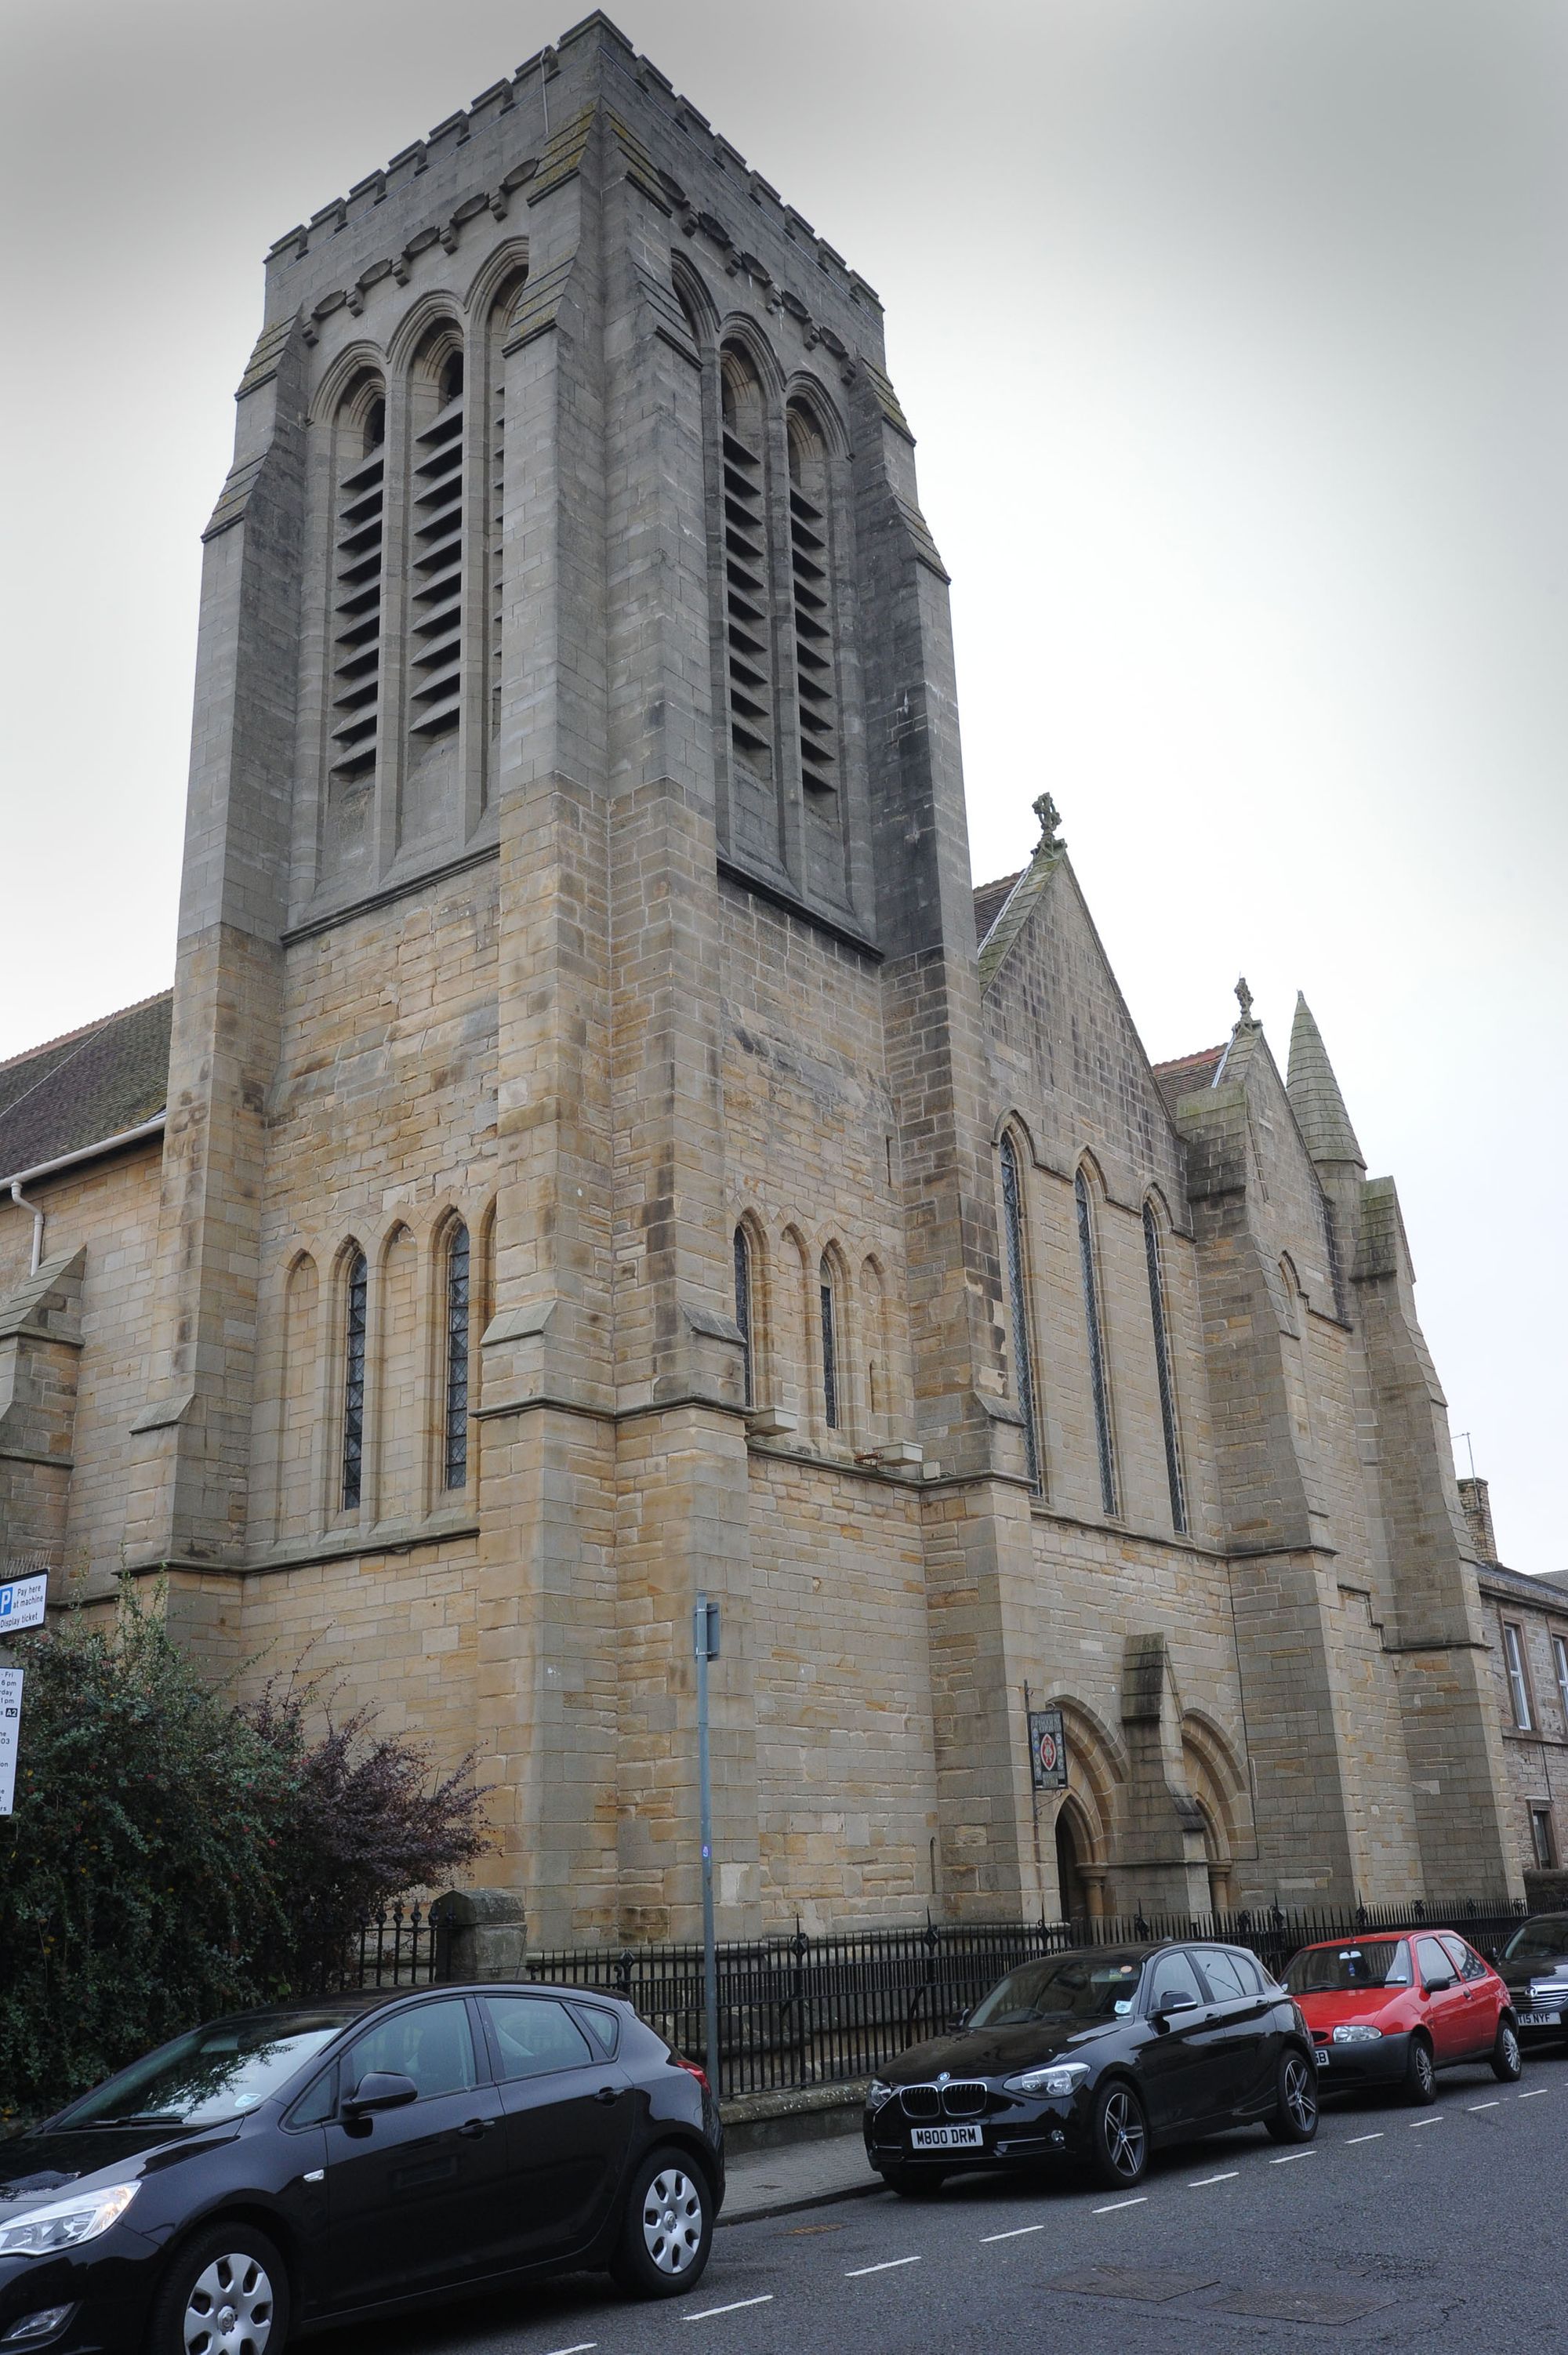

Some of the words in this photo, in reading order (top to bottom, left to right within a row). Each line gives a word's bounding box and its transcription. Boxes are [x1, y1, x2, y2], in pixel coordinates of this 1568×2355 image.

[17, 1588, 27, 1597] Pay
[29, 1585, 41, 1594] here
[20, 1595, 43, 1606] machine
[0, 1617, 20, 1628] Display
[21, 1613, 38, 1623] ticket
[1533, 2013, 1550, 2023] NYF
[916, 2129, 947, 2145] M800
[950, 2128, 977, 2143] DRM
